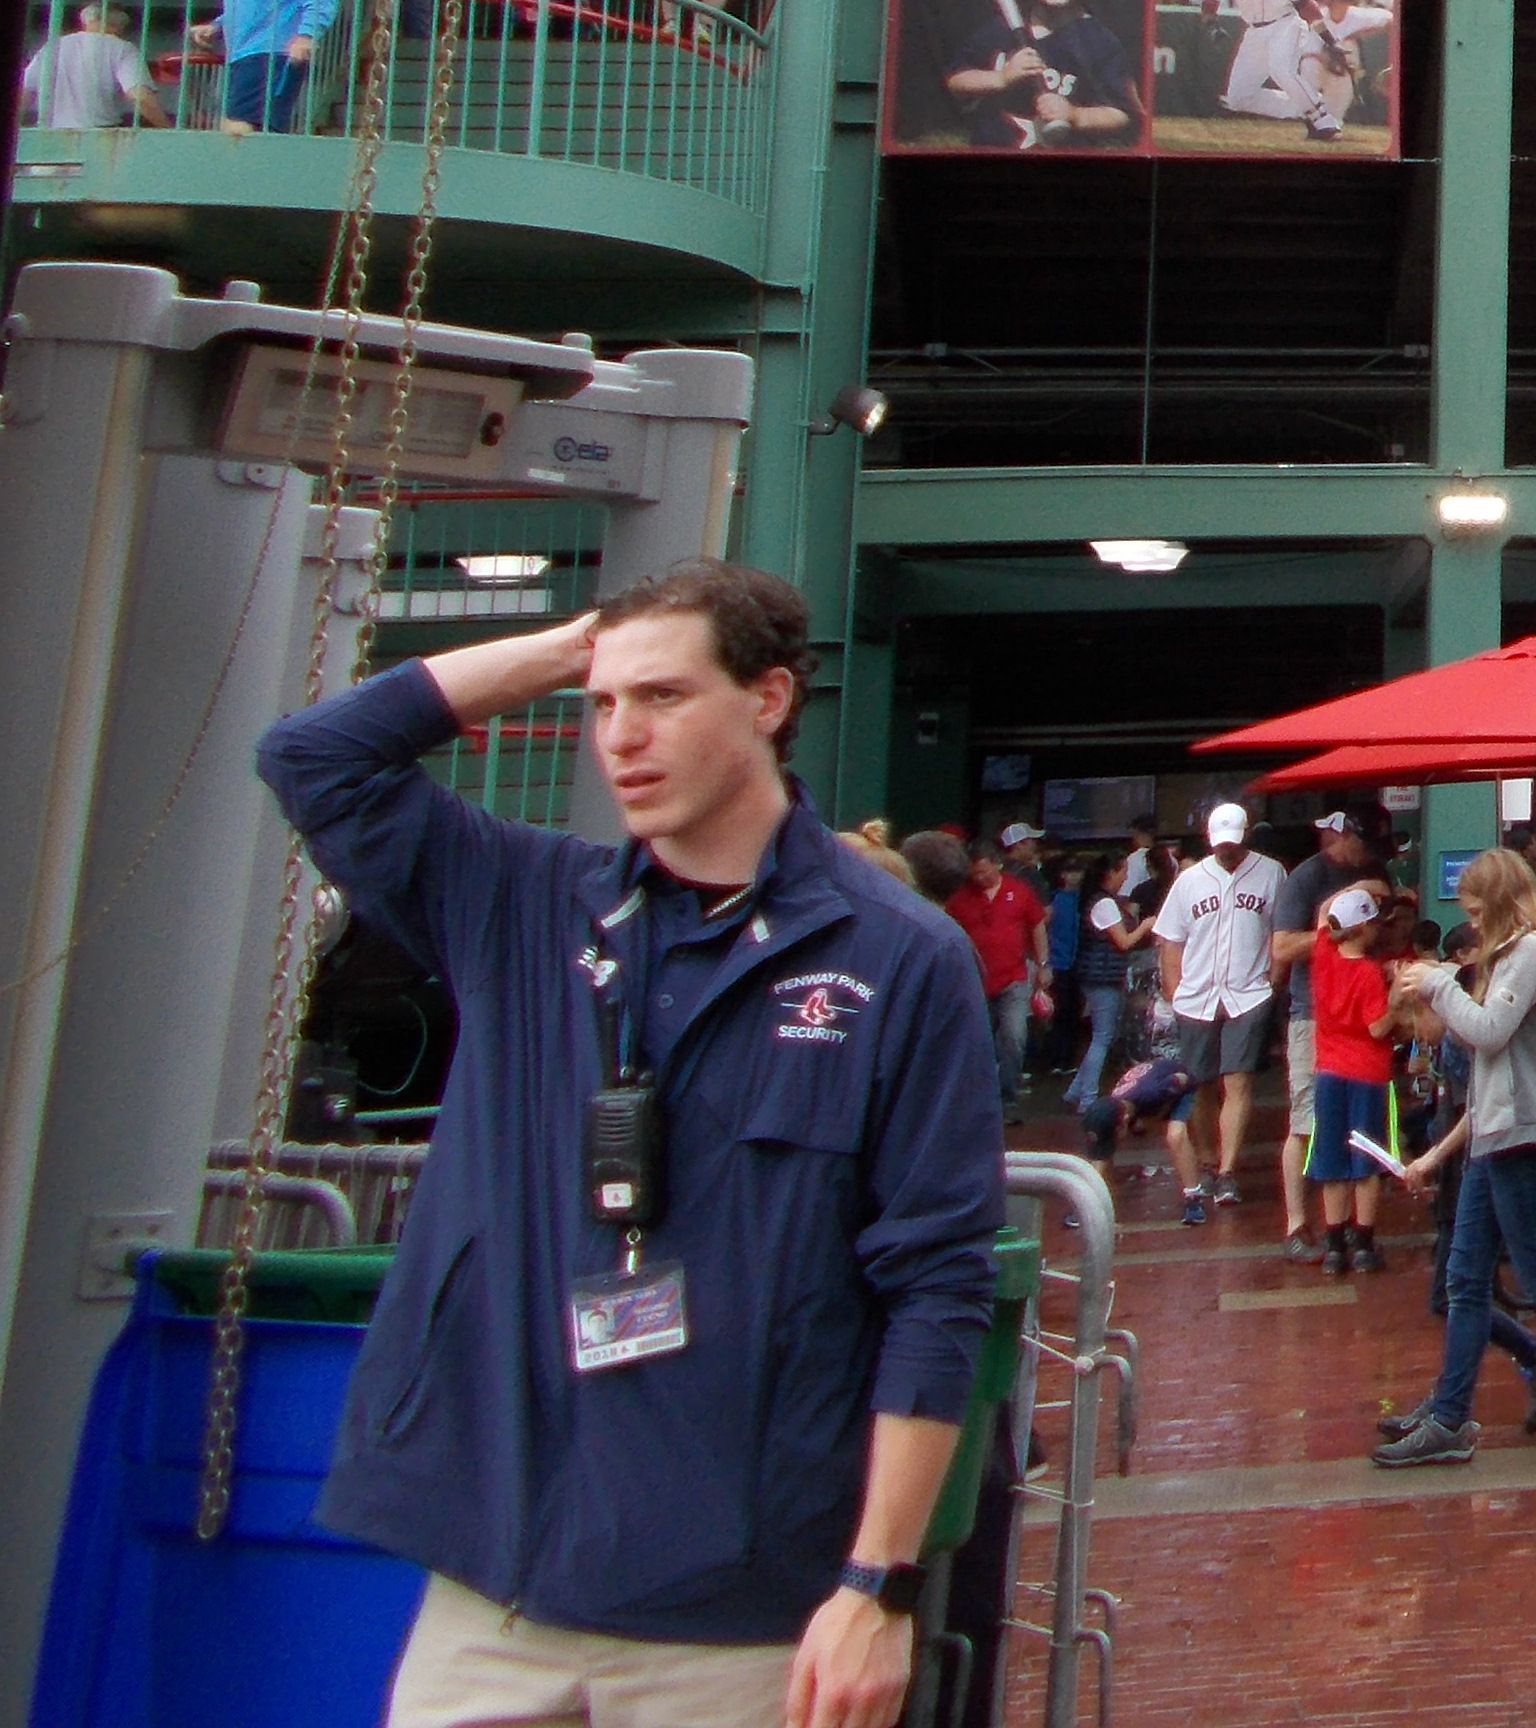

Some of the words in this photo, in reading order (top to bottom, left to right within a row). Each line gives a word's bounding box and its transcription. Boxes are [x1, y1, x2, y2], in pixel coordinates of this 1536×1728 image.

[1191, 894, 1221, 921] RED
[1235, 892, 1267, 915] SOX
[774, 972, 838, 995] FENWAY
[837, 974, 875, 1003] PARK
[778, 1024, 848, 1044] SECURITY
